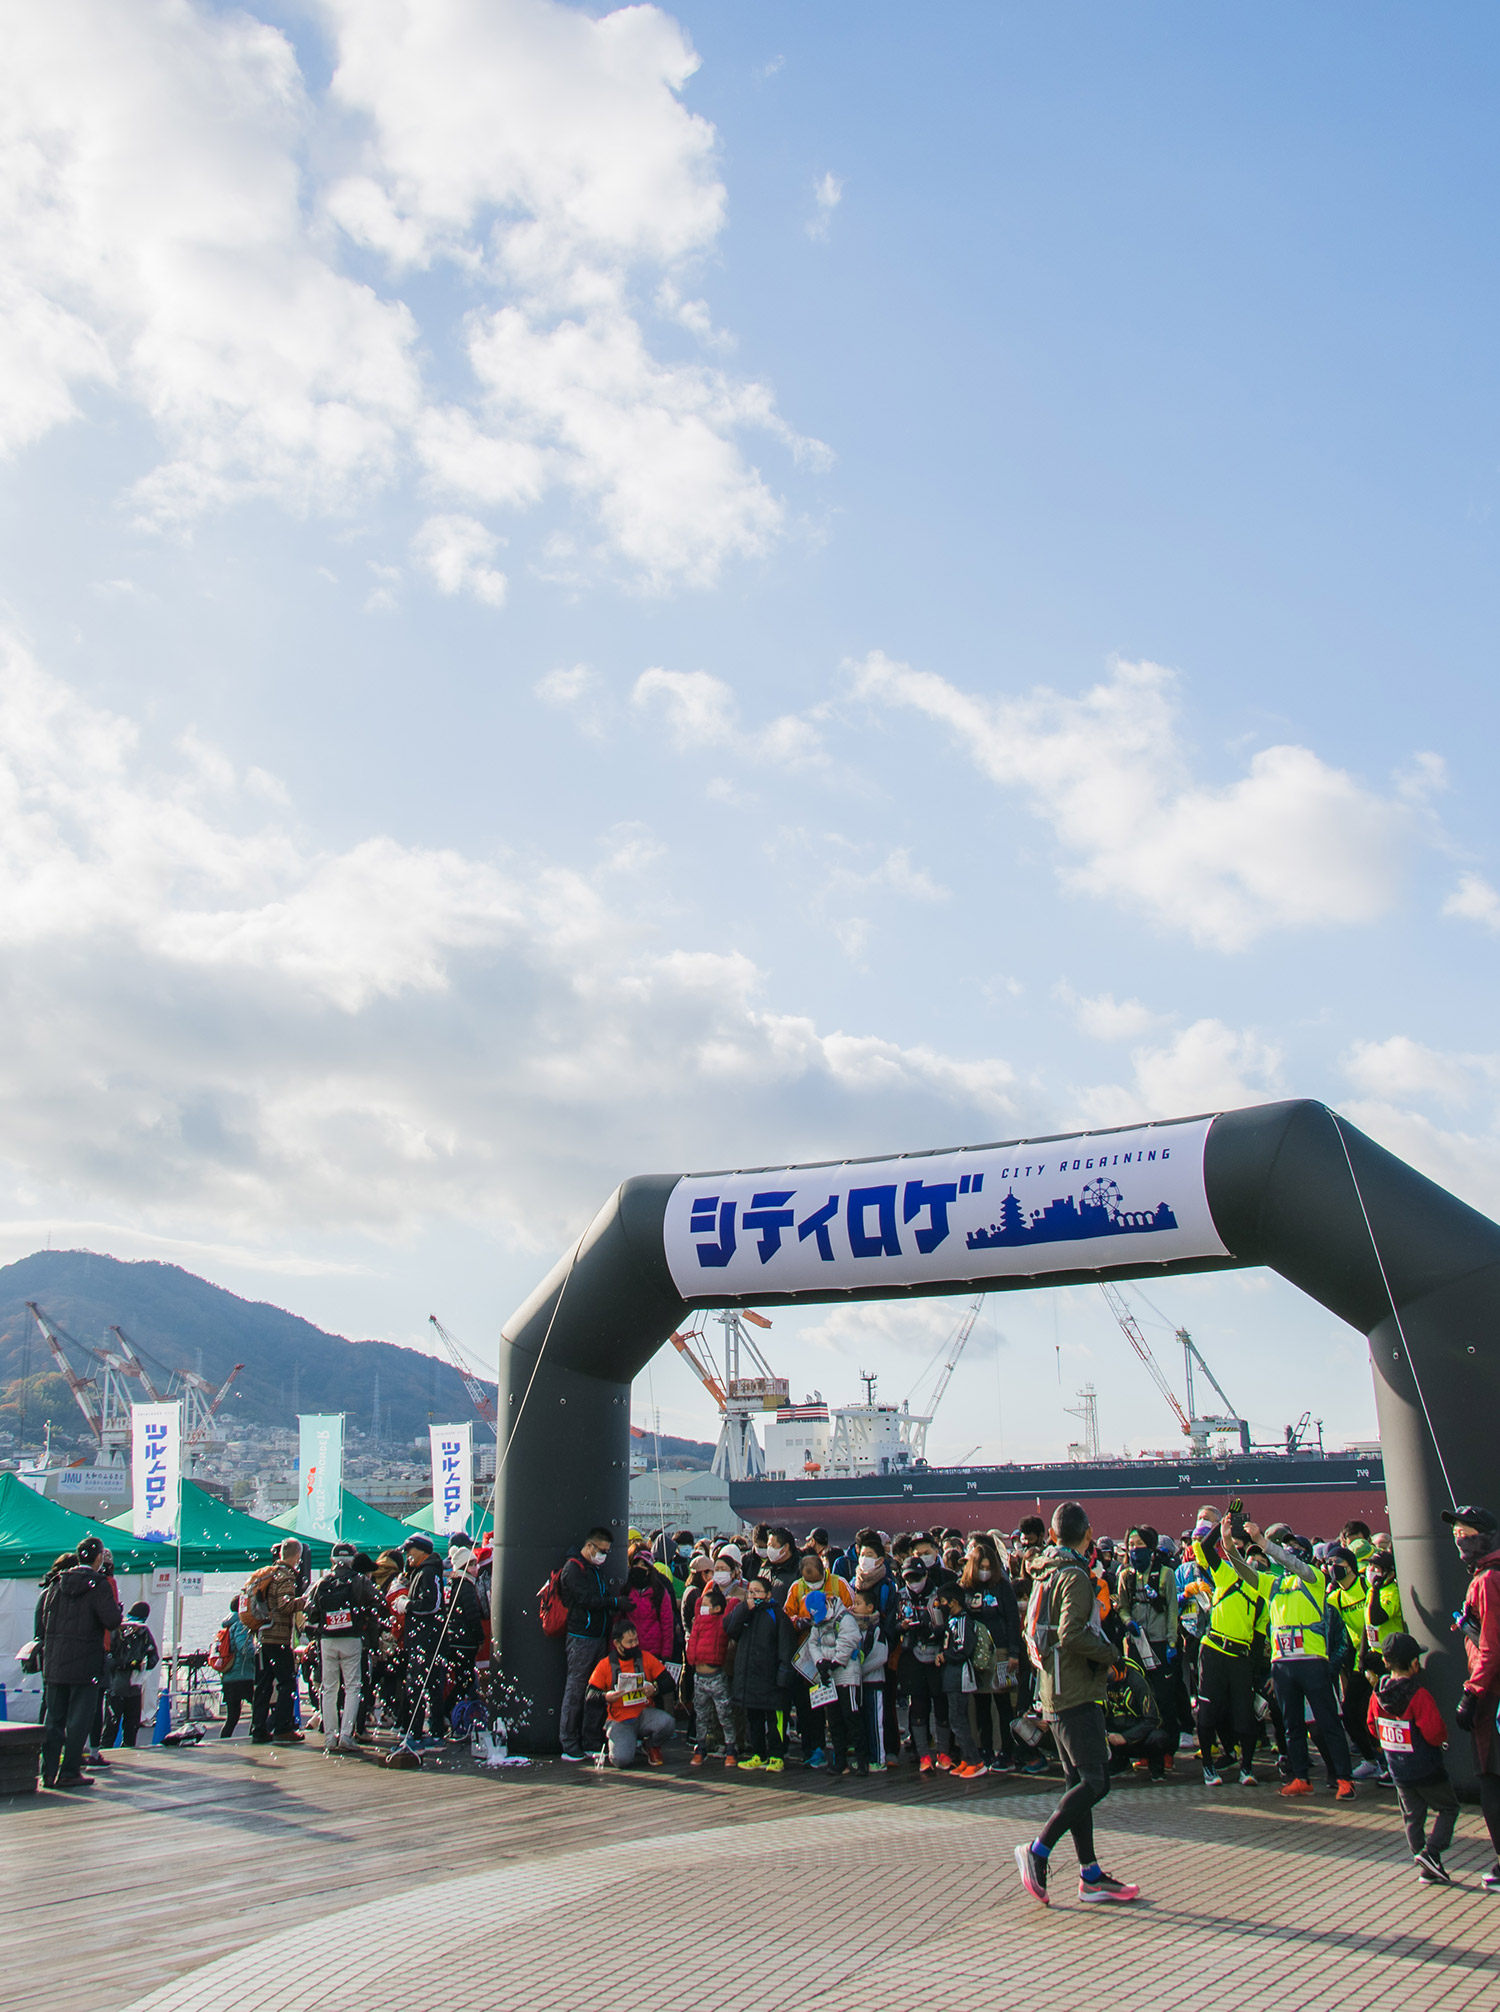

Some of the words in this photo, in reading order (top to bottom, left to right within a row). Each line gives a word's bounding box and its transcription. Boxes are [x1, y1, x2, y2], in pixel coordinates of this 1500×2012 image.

[1001, 1164, 1045, 1179] CITY
[1059, 1148, 1170, 1172] ROGAINING
[690, 1173, 984, 1268] シティロゲ
[61, 1472, 82, 1483] JMU
[330, 1614, 348, 1625] 322
[627, 1690, 644, 1701] 121
[1382, 1726, 1404, 1743] 406
